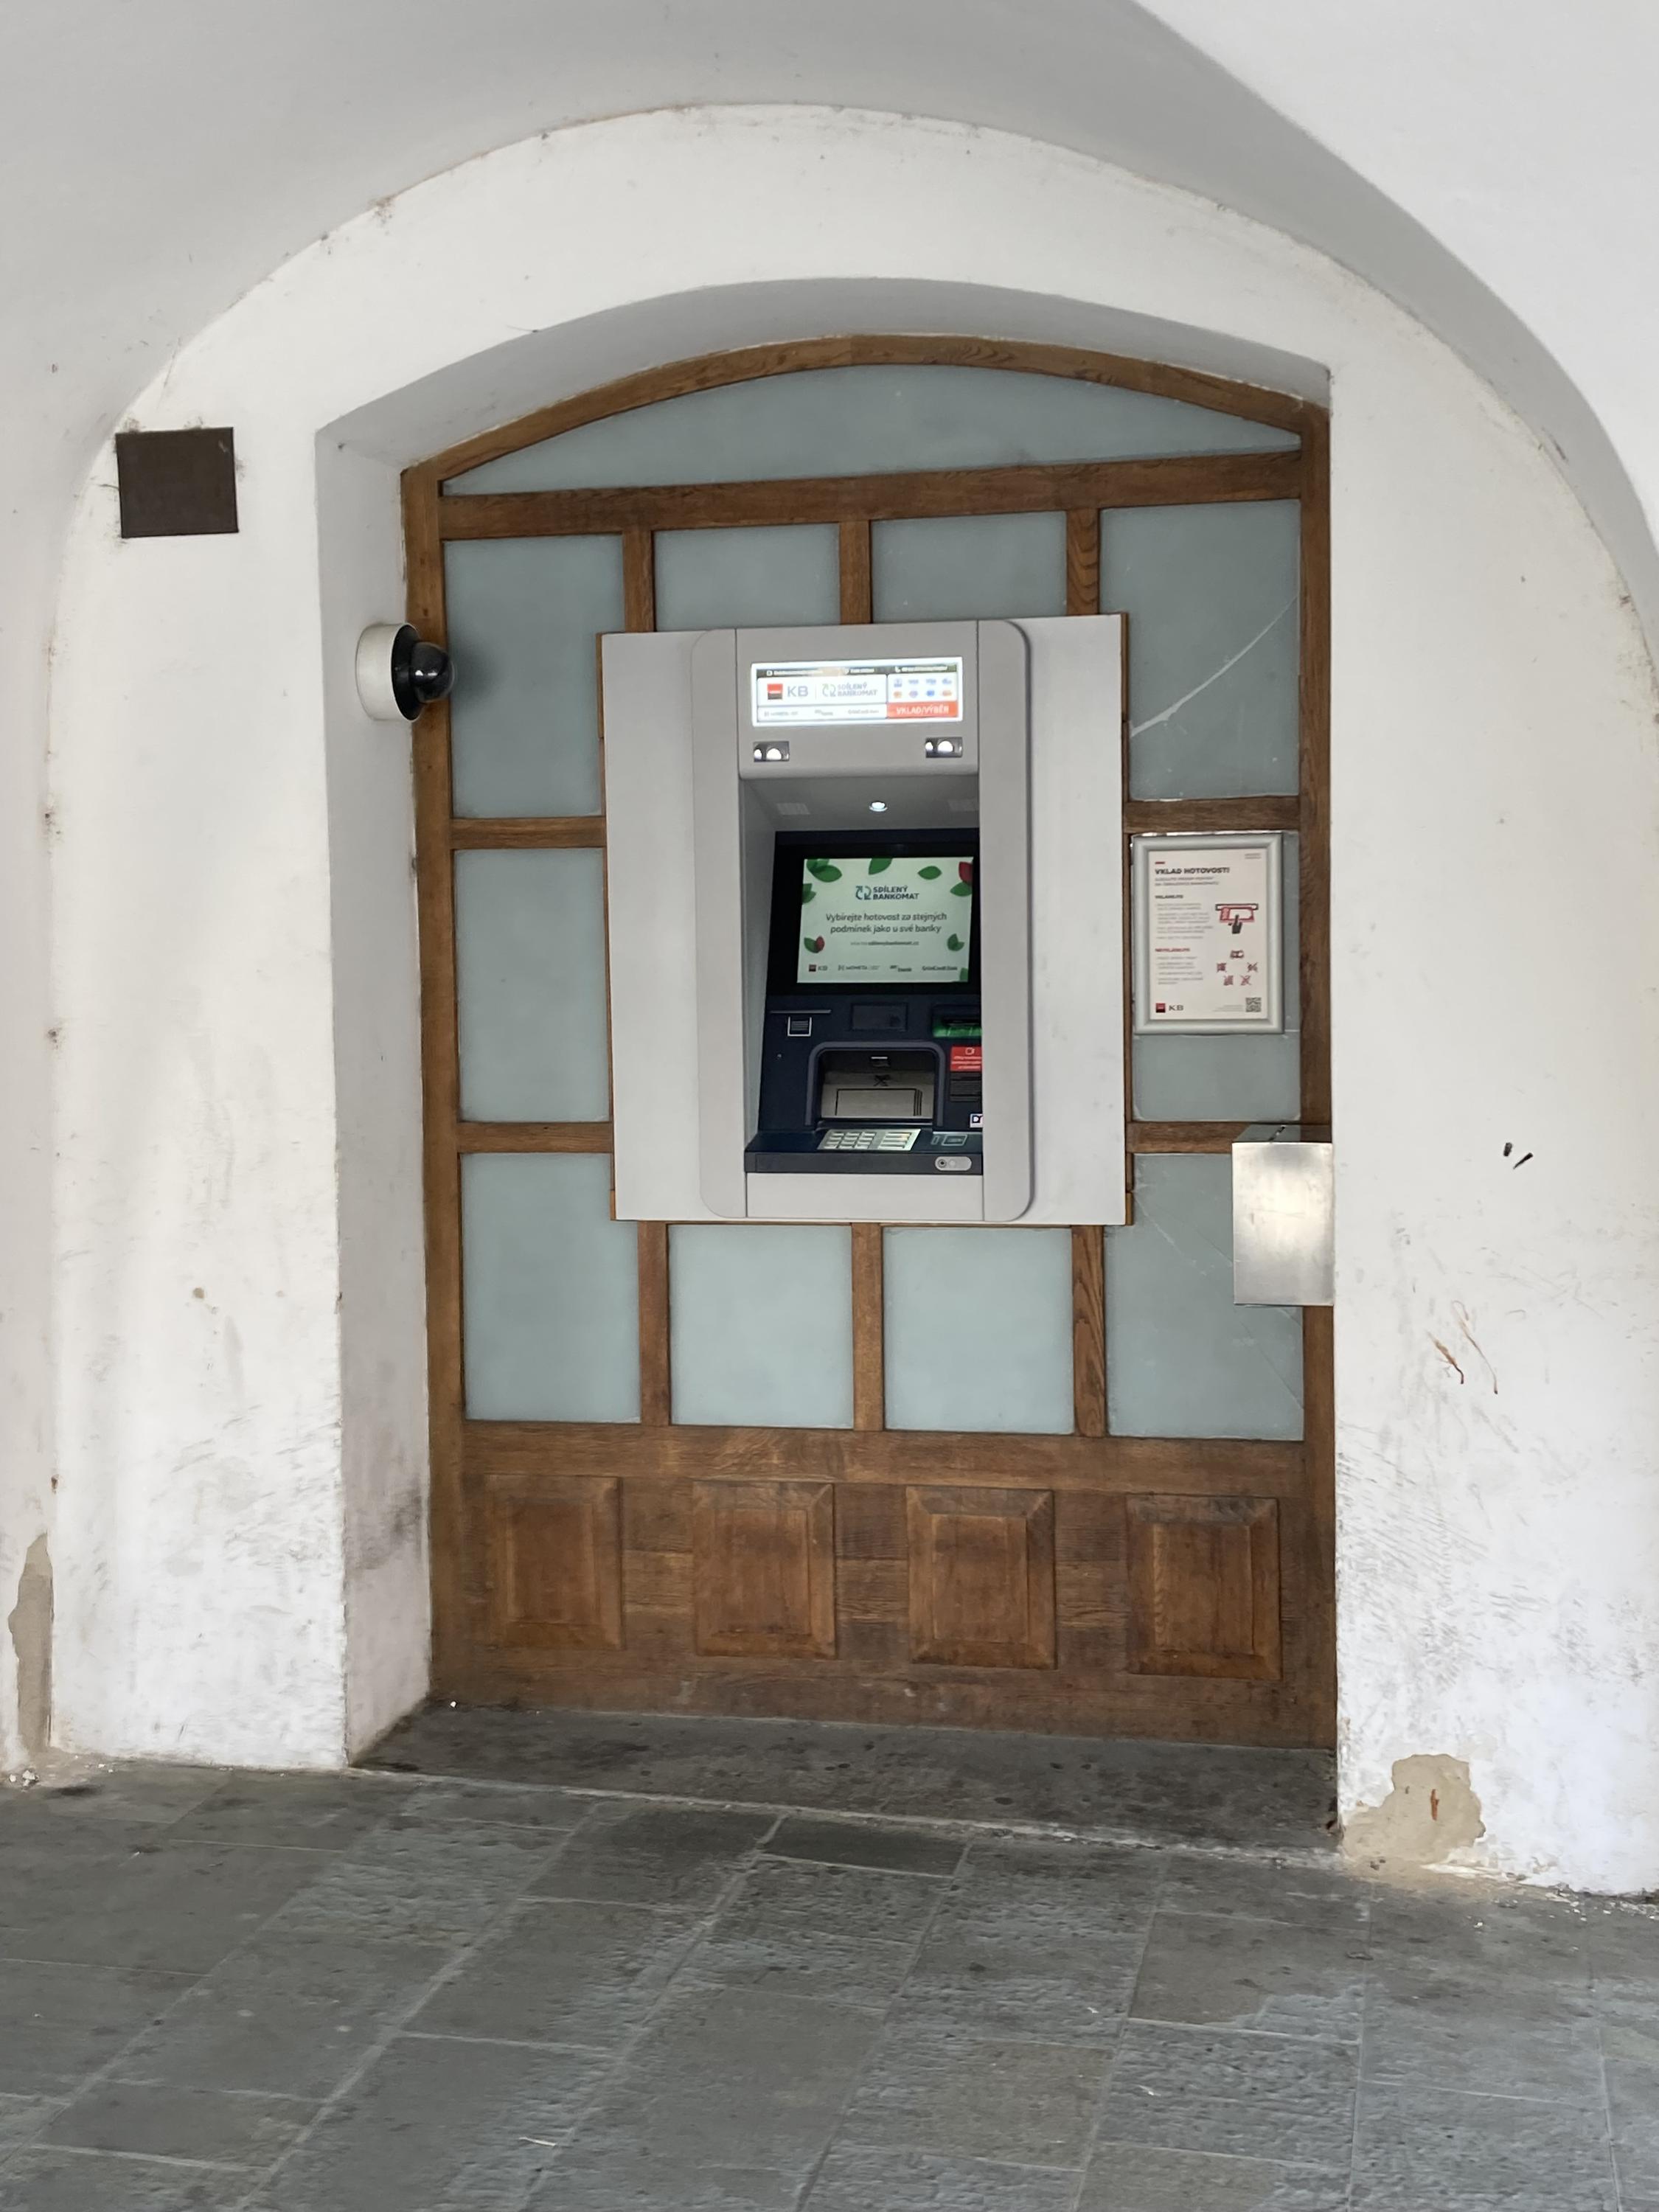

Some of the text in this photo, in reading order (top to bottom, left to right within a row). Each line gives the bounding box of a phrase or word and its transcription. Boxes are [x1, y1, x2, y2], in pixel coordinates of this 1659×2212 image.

[787, 685, 809, 698] KB
[1183, 867, 1231, 875] HOTOVOSTI
[873, 885, 908, 894] SDÍLENÝ
[872, 892, 919, 900] BANKOMAT
[863, 912, 900, 921] hotovost
[912, 912, 947, 924] stejných
[830, 925, 872, 934] podmínek
[873, 925, 891, 934] jako
[900, 925, 914, 933] své
[915, 924, 942, 934] banky
[1168, 1004, 1184, 1012] KB
